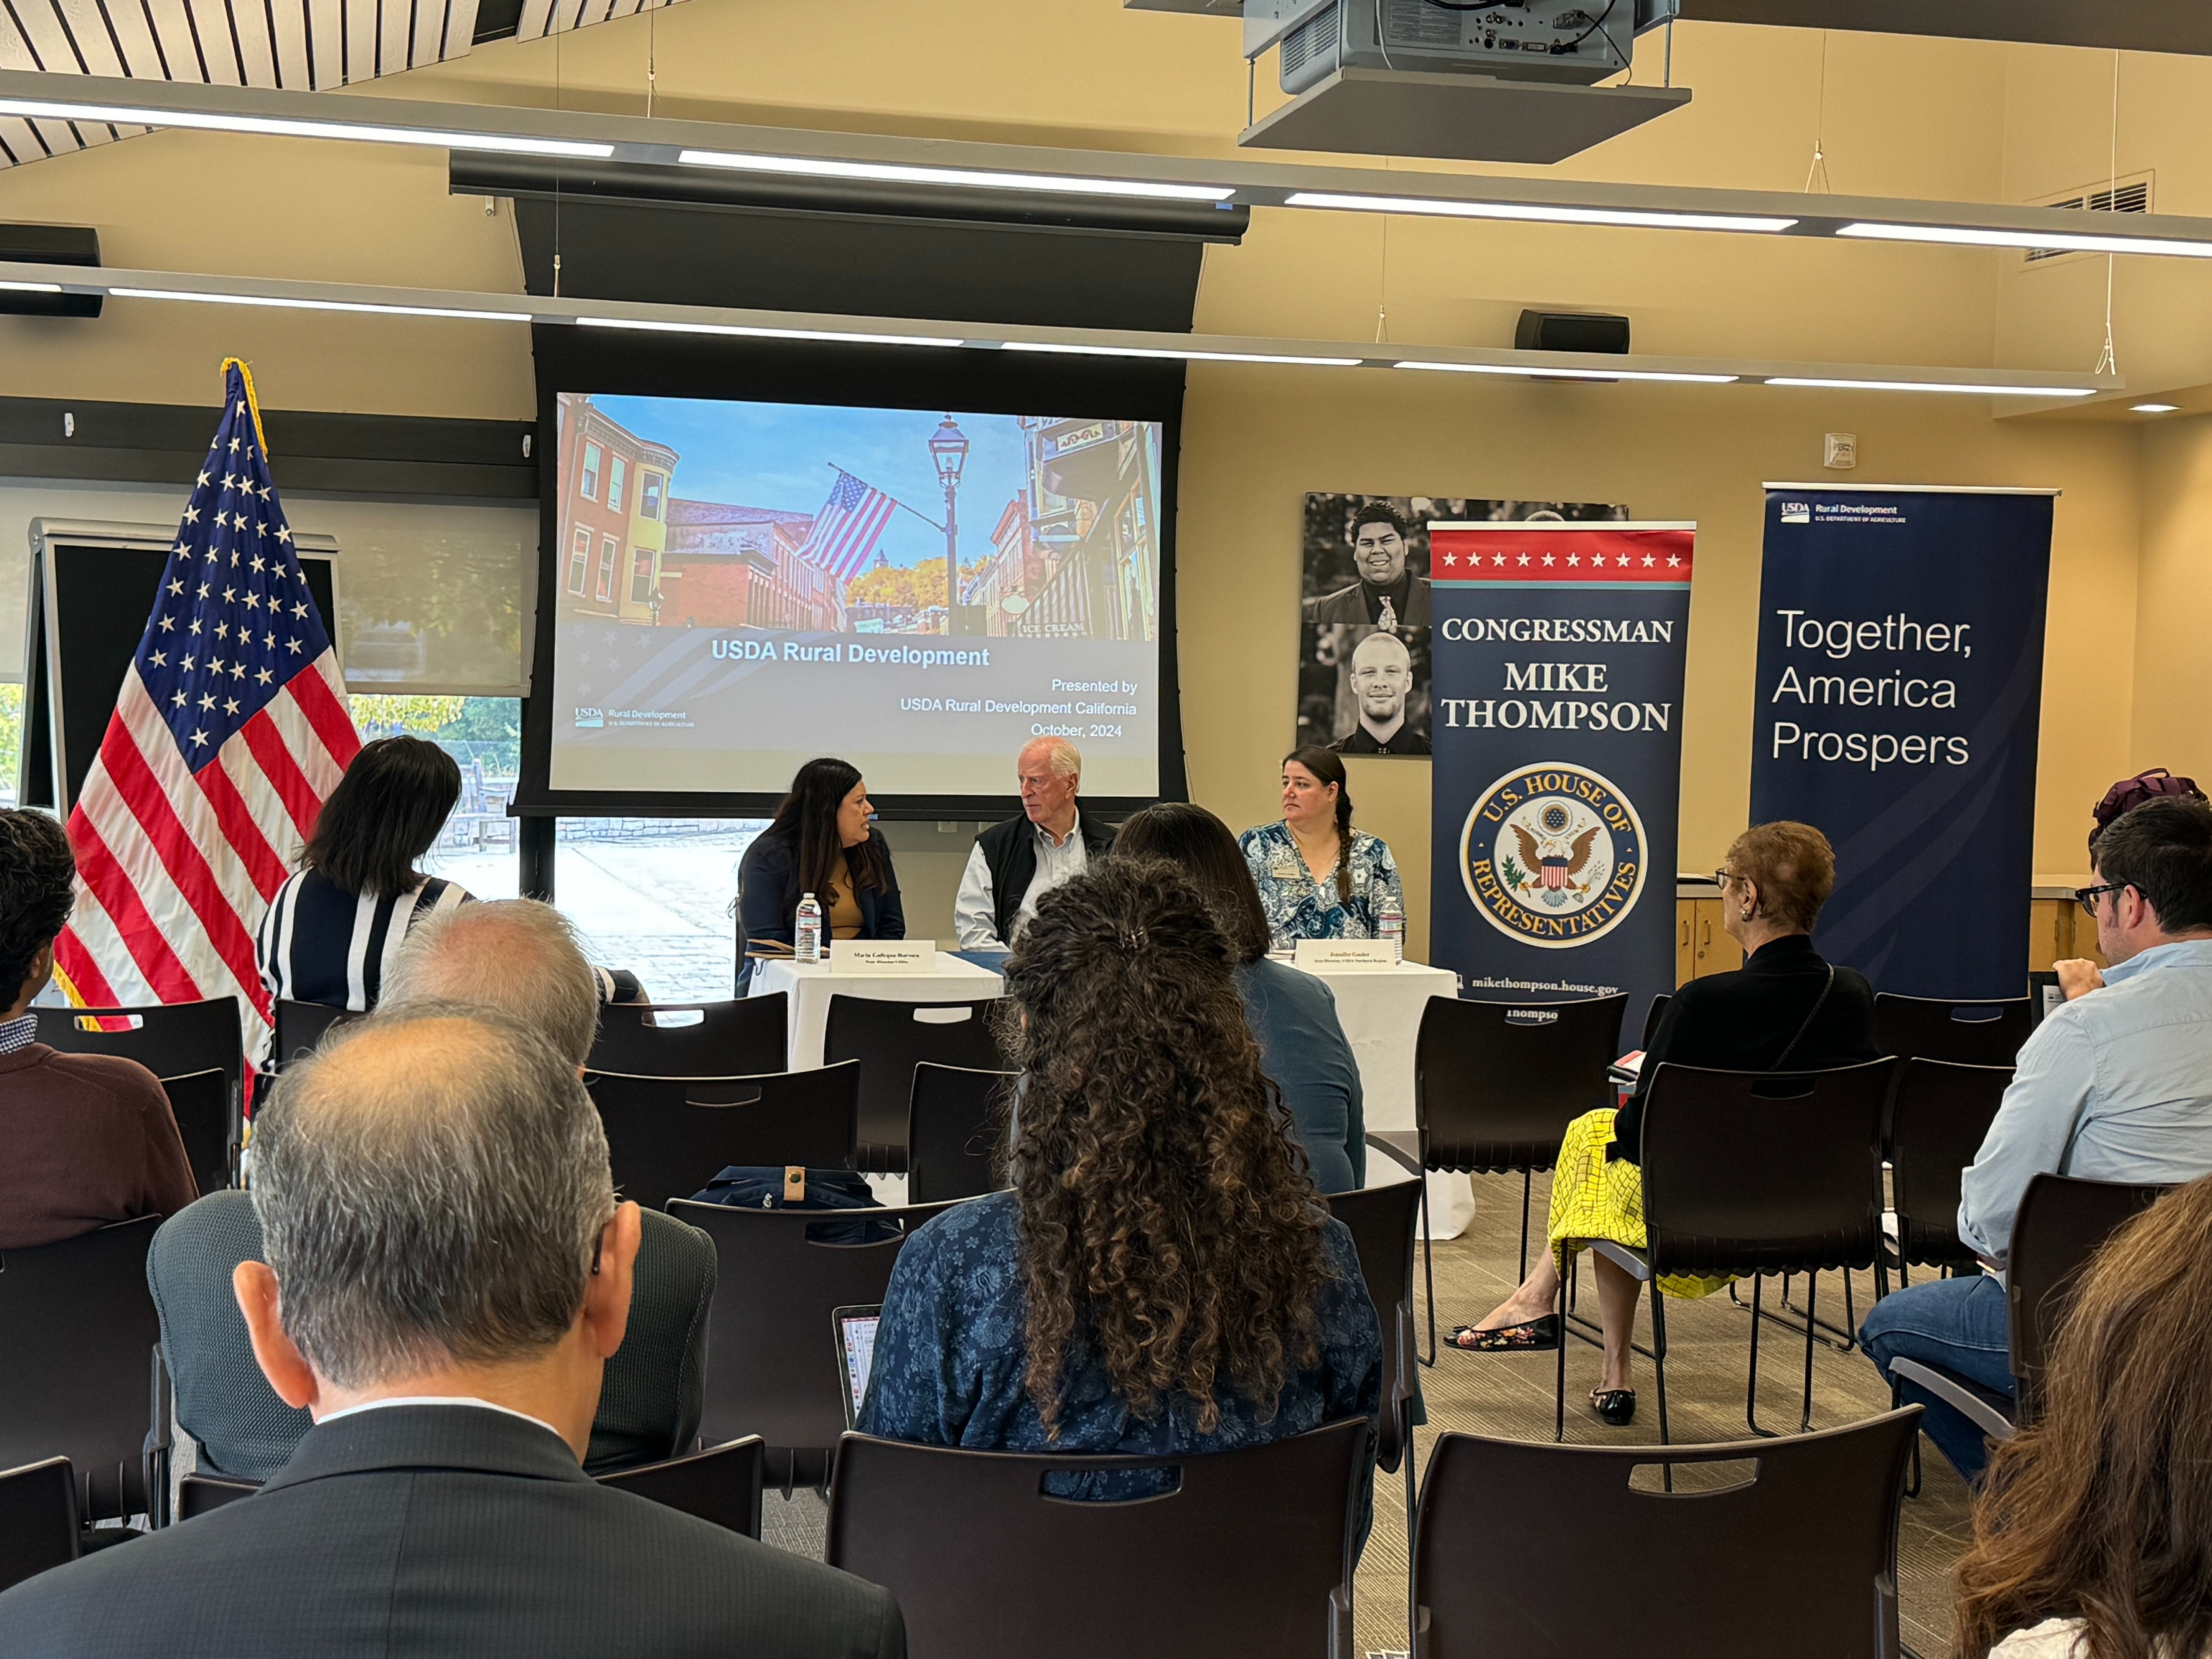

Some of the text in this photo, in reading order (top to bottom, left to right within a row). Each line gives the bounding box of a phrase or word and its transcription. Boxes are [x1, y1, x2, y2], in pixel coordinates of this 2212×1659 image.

[1782, 502, 1898, 515] USDA Rural Development
[1044, 623, 1085, 632] CREAM
[1442, 618, 1674, 643] CONGRESSMAN
[1777, 610, 1971, 659] Together,
[713, 640, 989, 669] USDA Rural Development
[1052, 679, 1138, 695] Presented by
[1503, 663, 1608, 692] MIKE
[1772, 666, 1956, 708] America
[575, 708, 686, 720] USDA Rural Development
[901, 698, 1137, 716] USDA Rural Development California
[1441, 699, 1671, 731] THOMPSON
[1031, 723, 1122, 738] October, 2024
[1773, 721, 1969, 771] Prospers
[1483, 773, 1632, 832] U.S. HOUSE OF
[1472, 858, 1636, 936] REPRESENTATIVES
[1472, 977, 1619, 996] mikethompson.house.gov
